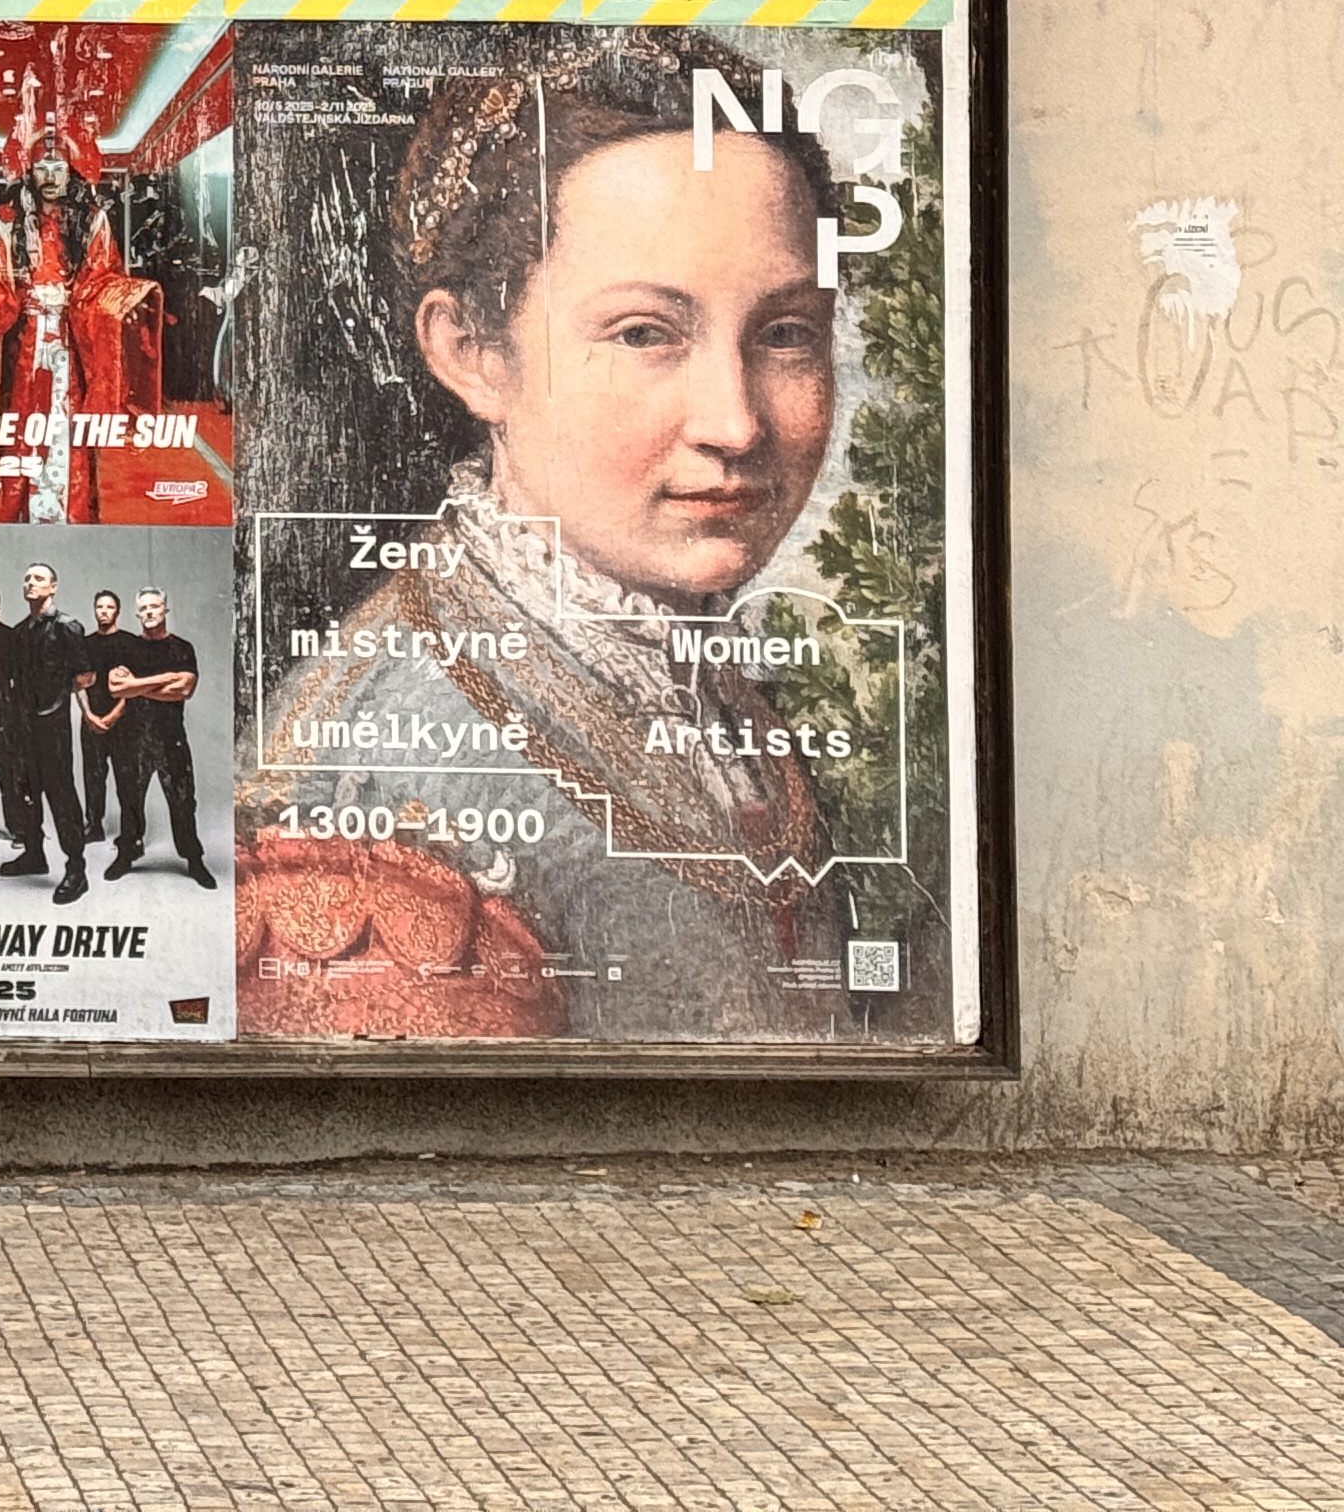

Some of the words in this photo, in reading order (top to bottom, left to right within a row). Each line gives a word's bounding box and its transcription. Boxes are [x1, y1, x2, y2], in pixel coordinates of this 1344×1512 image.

[23, 412, 63, 446] OF
[72, 414, 127, 447] THE
[133, 415, 197, 448] SUN
[349, 525, 465, 578] Ženy
[291, 620, 528, 667] mistryně
[672, 628, 820, 666] Women
[293, 715, 529, 758] umělkyně
[644, 720, 852, 757] Artists
[52, 925, 148, 958] DRIVE
